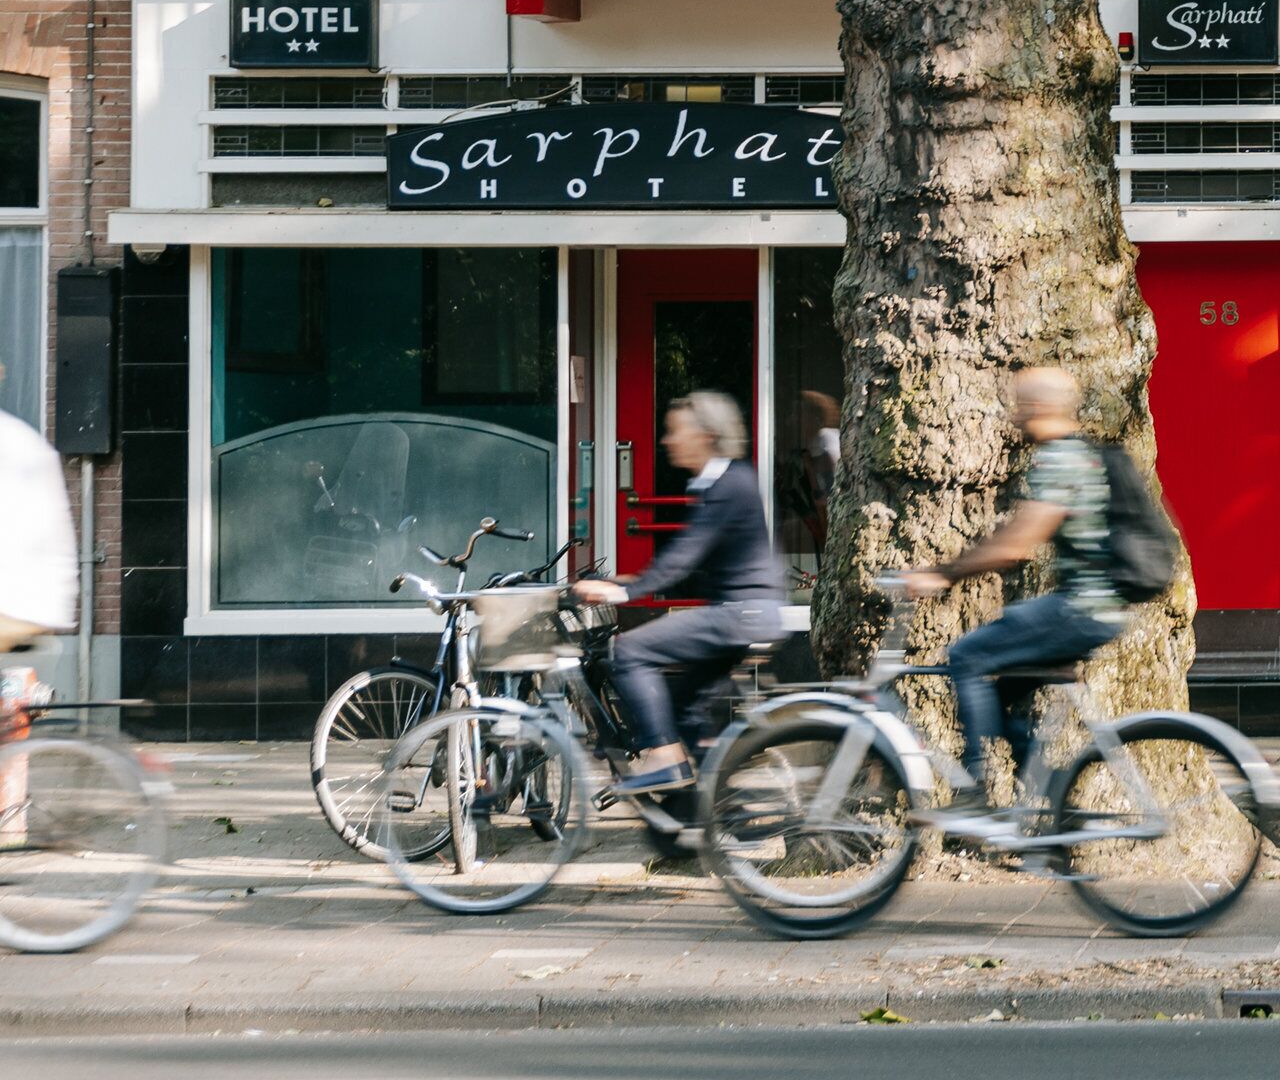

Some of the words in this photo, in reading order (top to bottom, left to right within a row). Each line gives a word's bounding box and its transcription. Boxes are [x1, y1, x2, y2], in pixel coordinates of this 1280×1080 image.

[241, 6, 360, 33] HOTEL
[1151, 1, 1266, 51] Sarphati
[398, 108, 842, 195] Sarphat
[480, 176, 829, 199] HOTEL
[1199, 300, 1240, 326] 58
